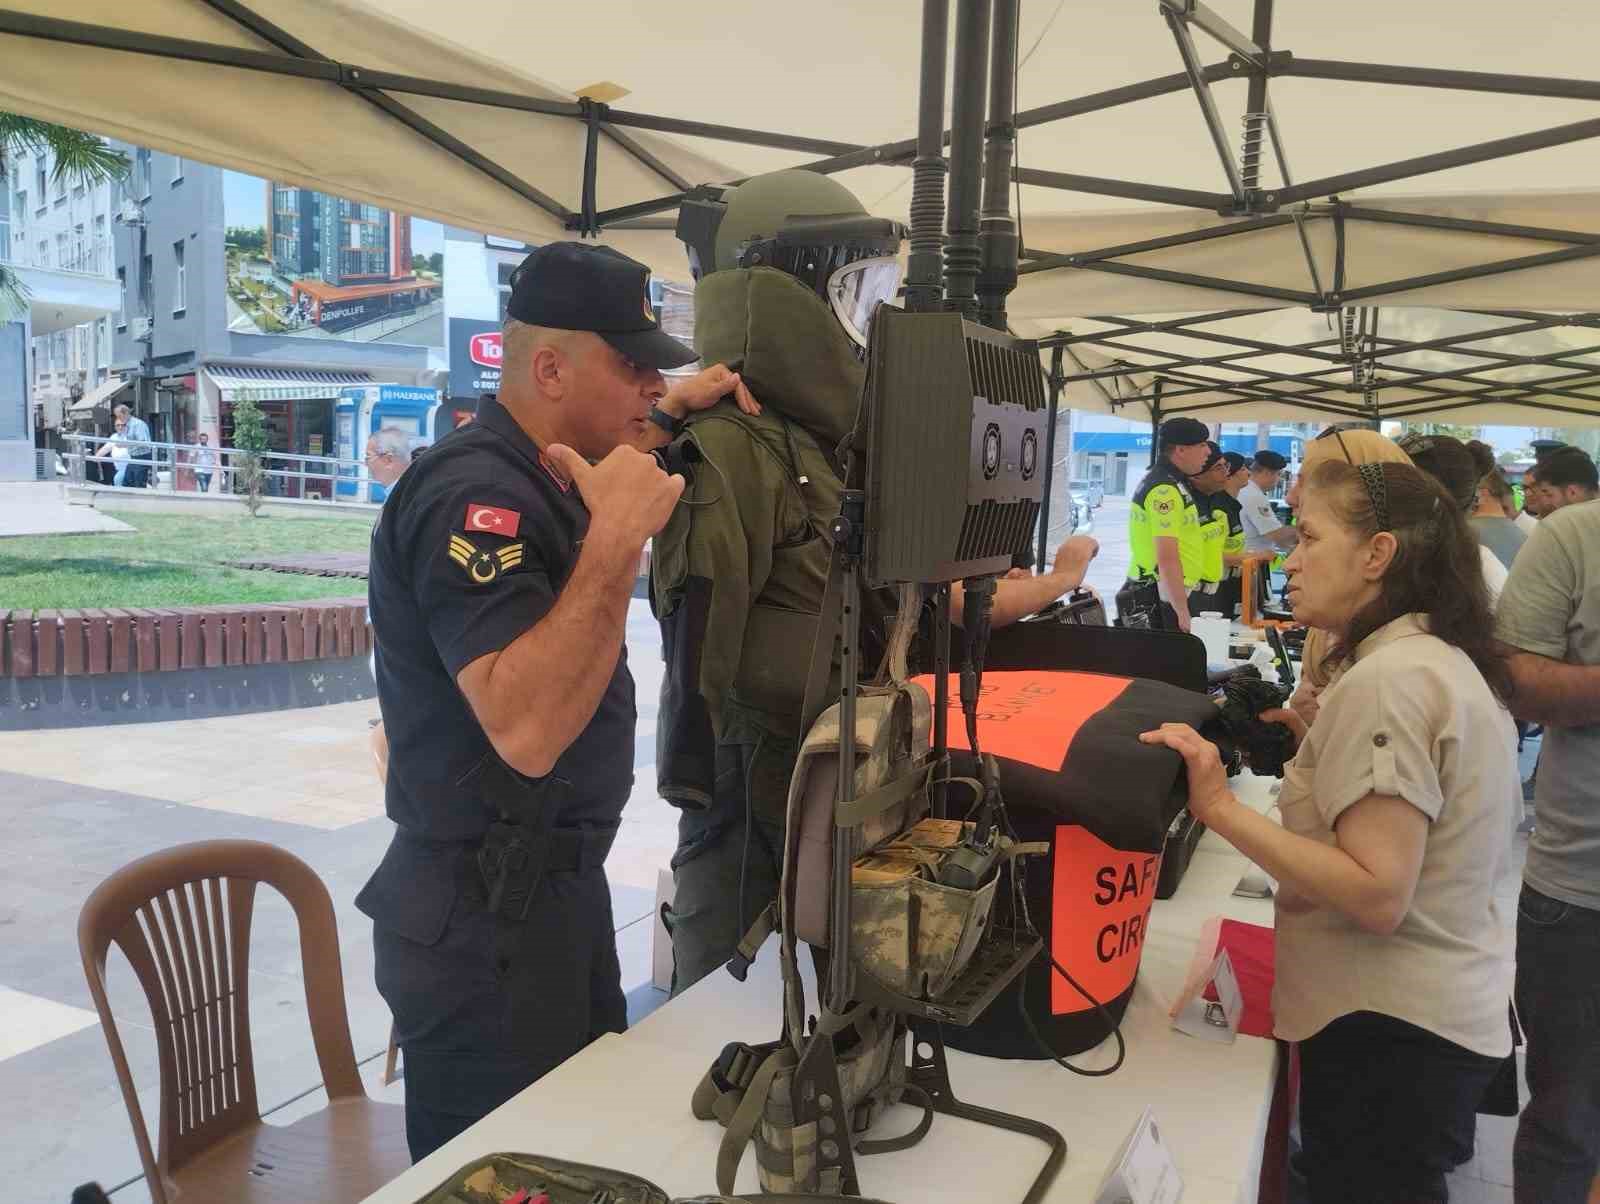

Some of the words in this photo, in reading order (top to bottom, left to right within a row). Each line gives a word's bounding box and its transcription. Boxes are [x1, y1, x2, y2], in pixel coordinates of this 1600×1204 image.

[478, 338, 503, 358] To
[1094, 856, 1158, 906] SAF
[1096, 908, 1150, 963] CIR
